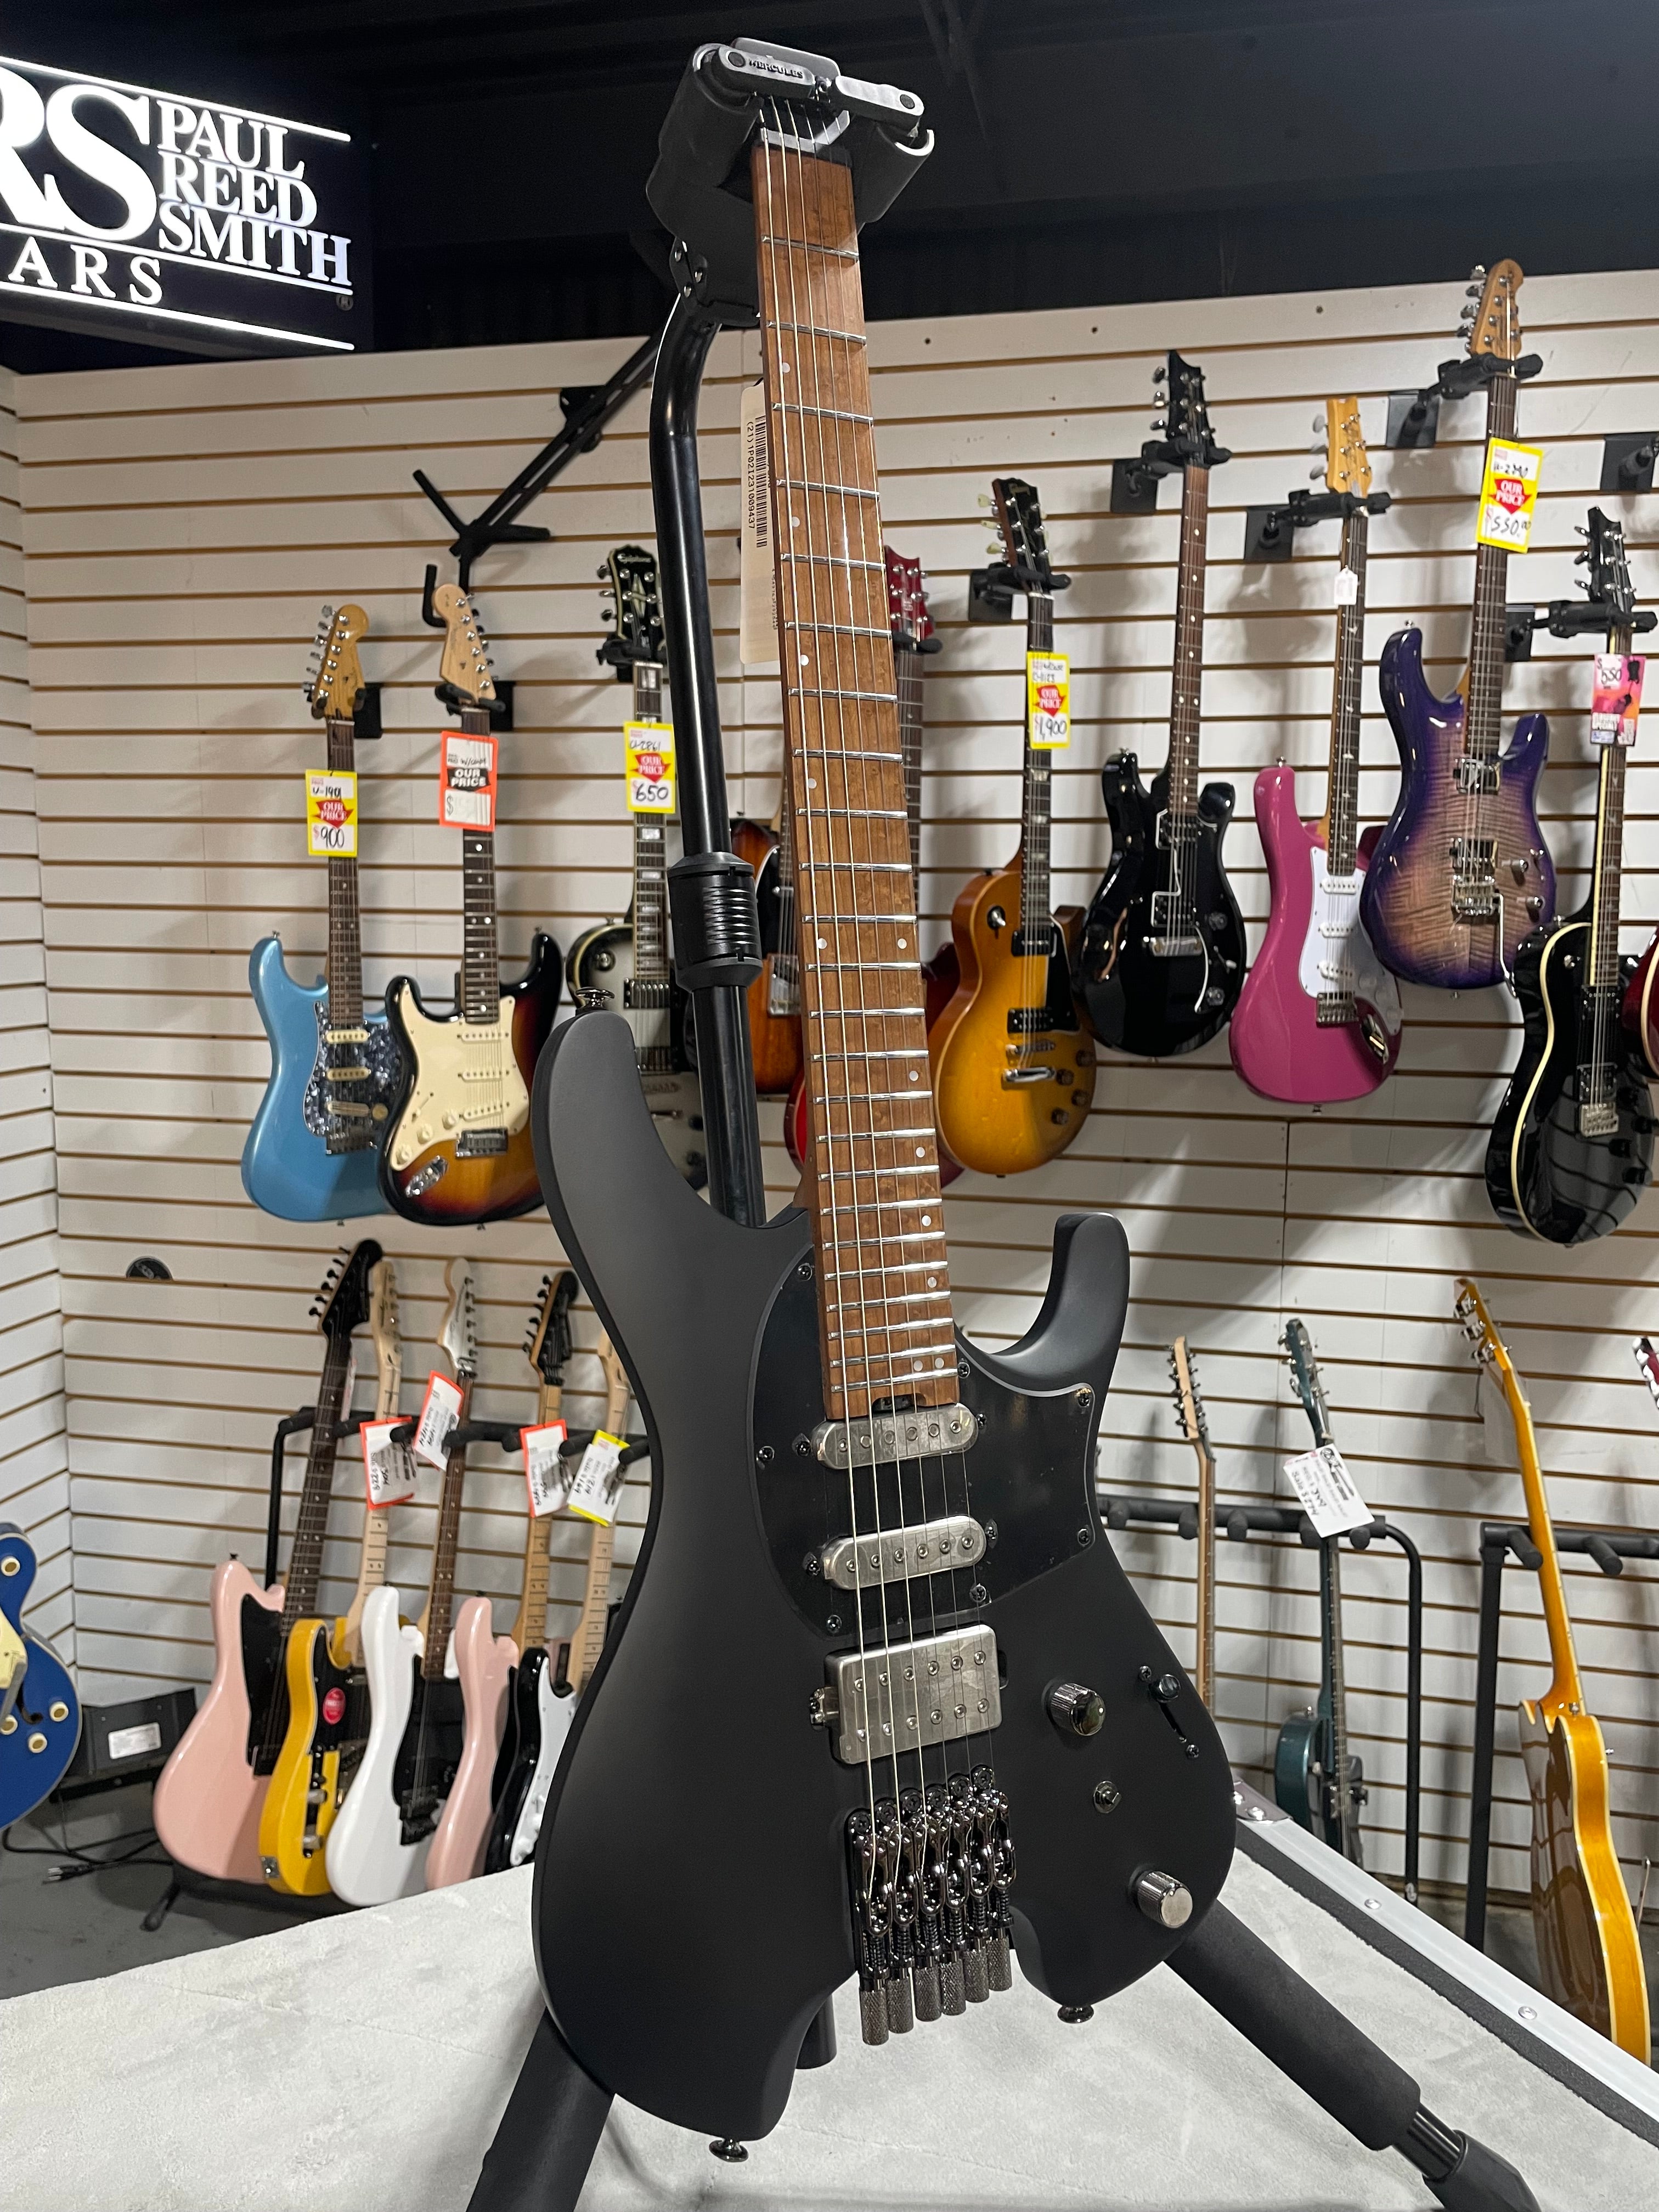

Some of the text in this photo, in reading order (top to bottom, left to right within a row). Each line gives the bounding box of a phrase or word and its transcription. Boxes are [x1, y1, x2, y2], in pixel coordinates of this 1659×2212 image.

[749, 59, 803, 79] HERCULES
[156, 99, 305, 180] PAUL
[159, 150, 318, 228] REED
[159, 201, 353, 286] SMITH
[450, 777, 487, 787] PRICE
[455, 769, 481, 778] OUR
